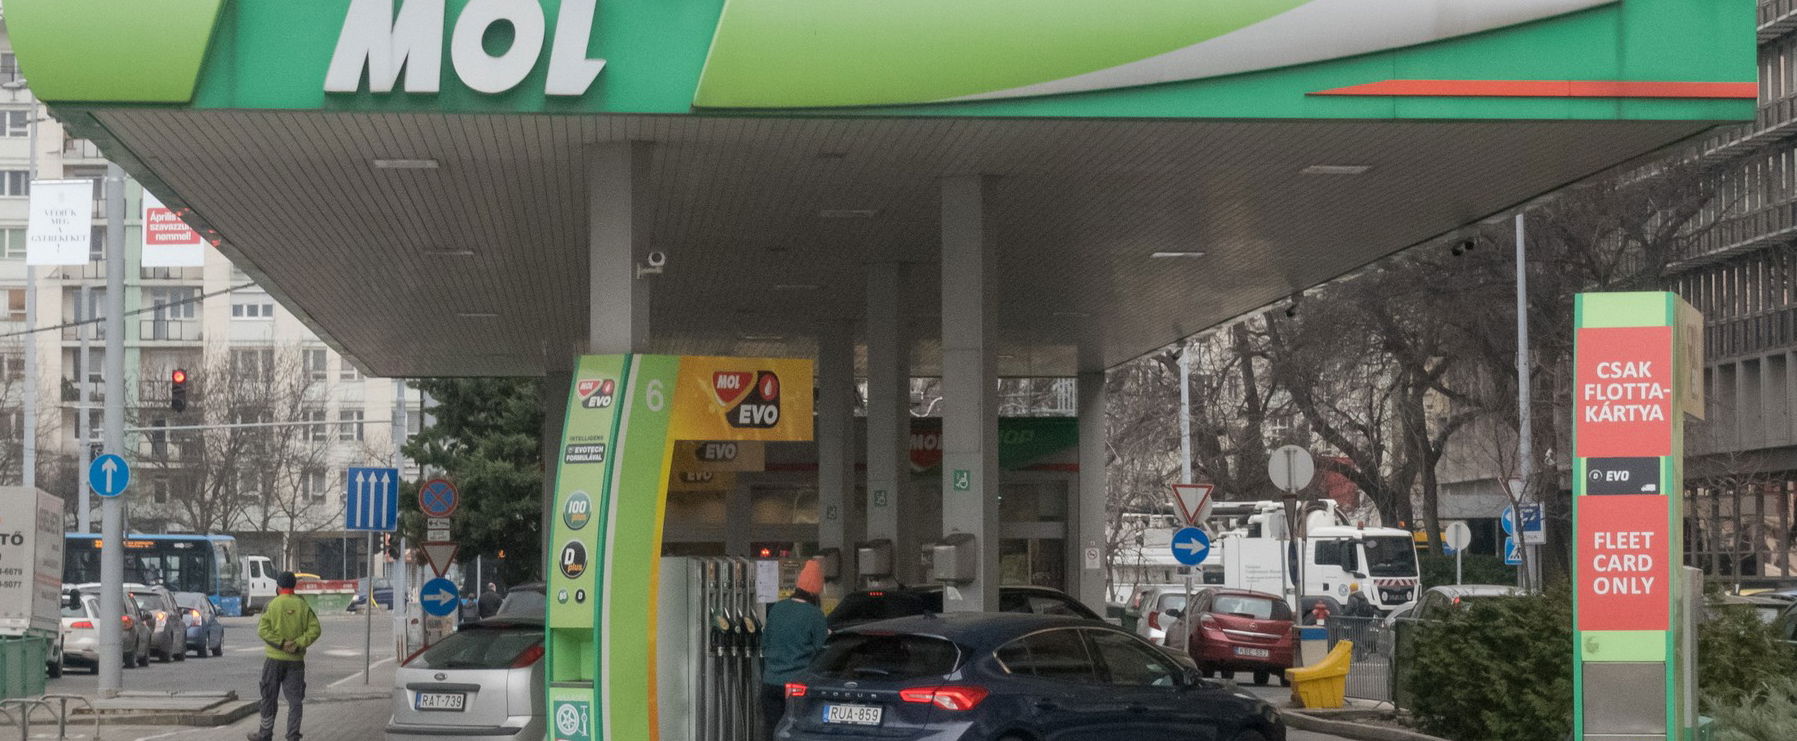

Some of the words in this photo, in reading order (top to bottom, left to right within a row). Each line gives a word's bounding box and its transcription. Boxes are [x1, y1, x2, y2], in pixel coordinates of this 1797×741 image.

[323, 0, 608, 95] MOL
[155, 231, 192, 241] nemmel!
[1596, 360, 1653, 379] CSAK
[717, 374, 741, 389] MOL
[646, 379, 664, 412] 6
[1584, 382, 1671, 401] FLOTTA-
[588, 395, 612, 407] EVO
[738, 404, 778, 425] EVO
[1585, 401, 1665, 422] KÁRTYA
[704, 443, 738, 459] EVO
[1605, 470, 1630, 481] EVO
[568, 500, 587, 513] 100
[1593, 531, 1655, 549] FLEET
[564, 547, 576, 565] D
[1592, 553, 1654, 572] CARD
[1592, 576, 1656, 595] ONLY
[422, 694, 463, 708] RAT-739
[830, 706, 880, 721] RUA-859
